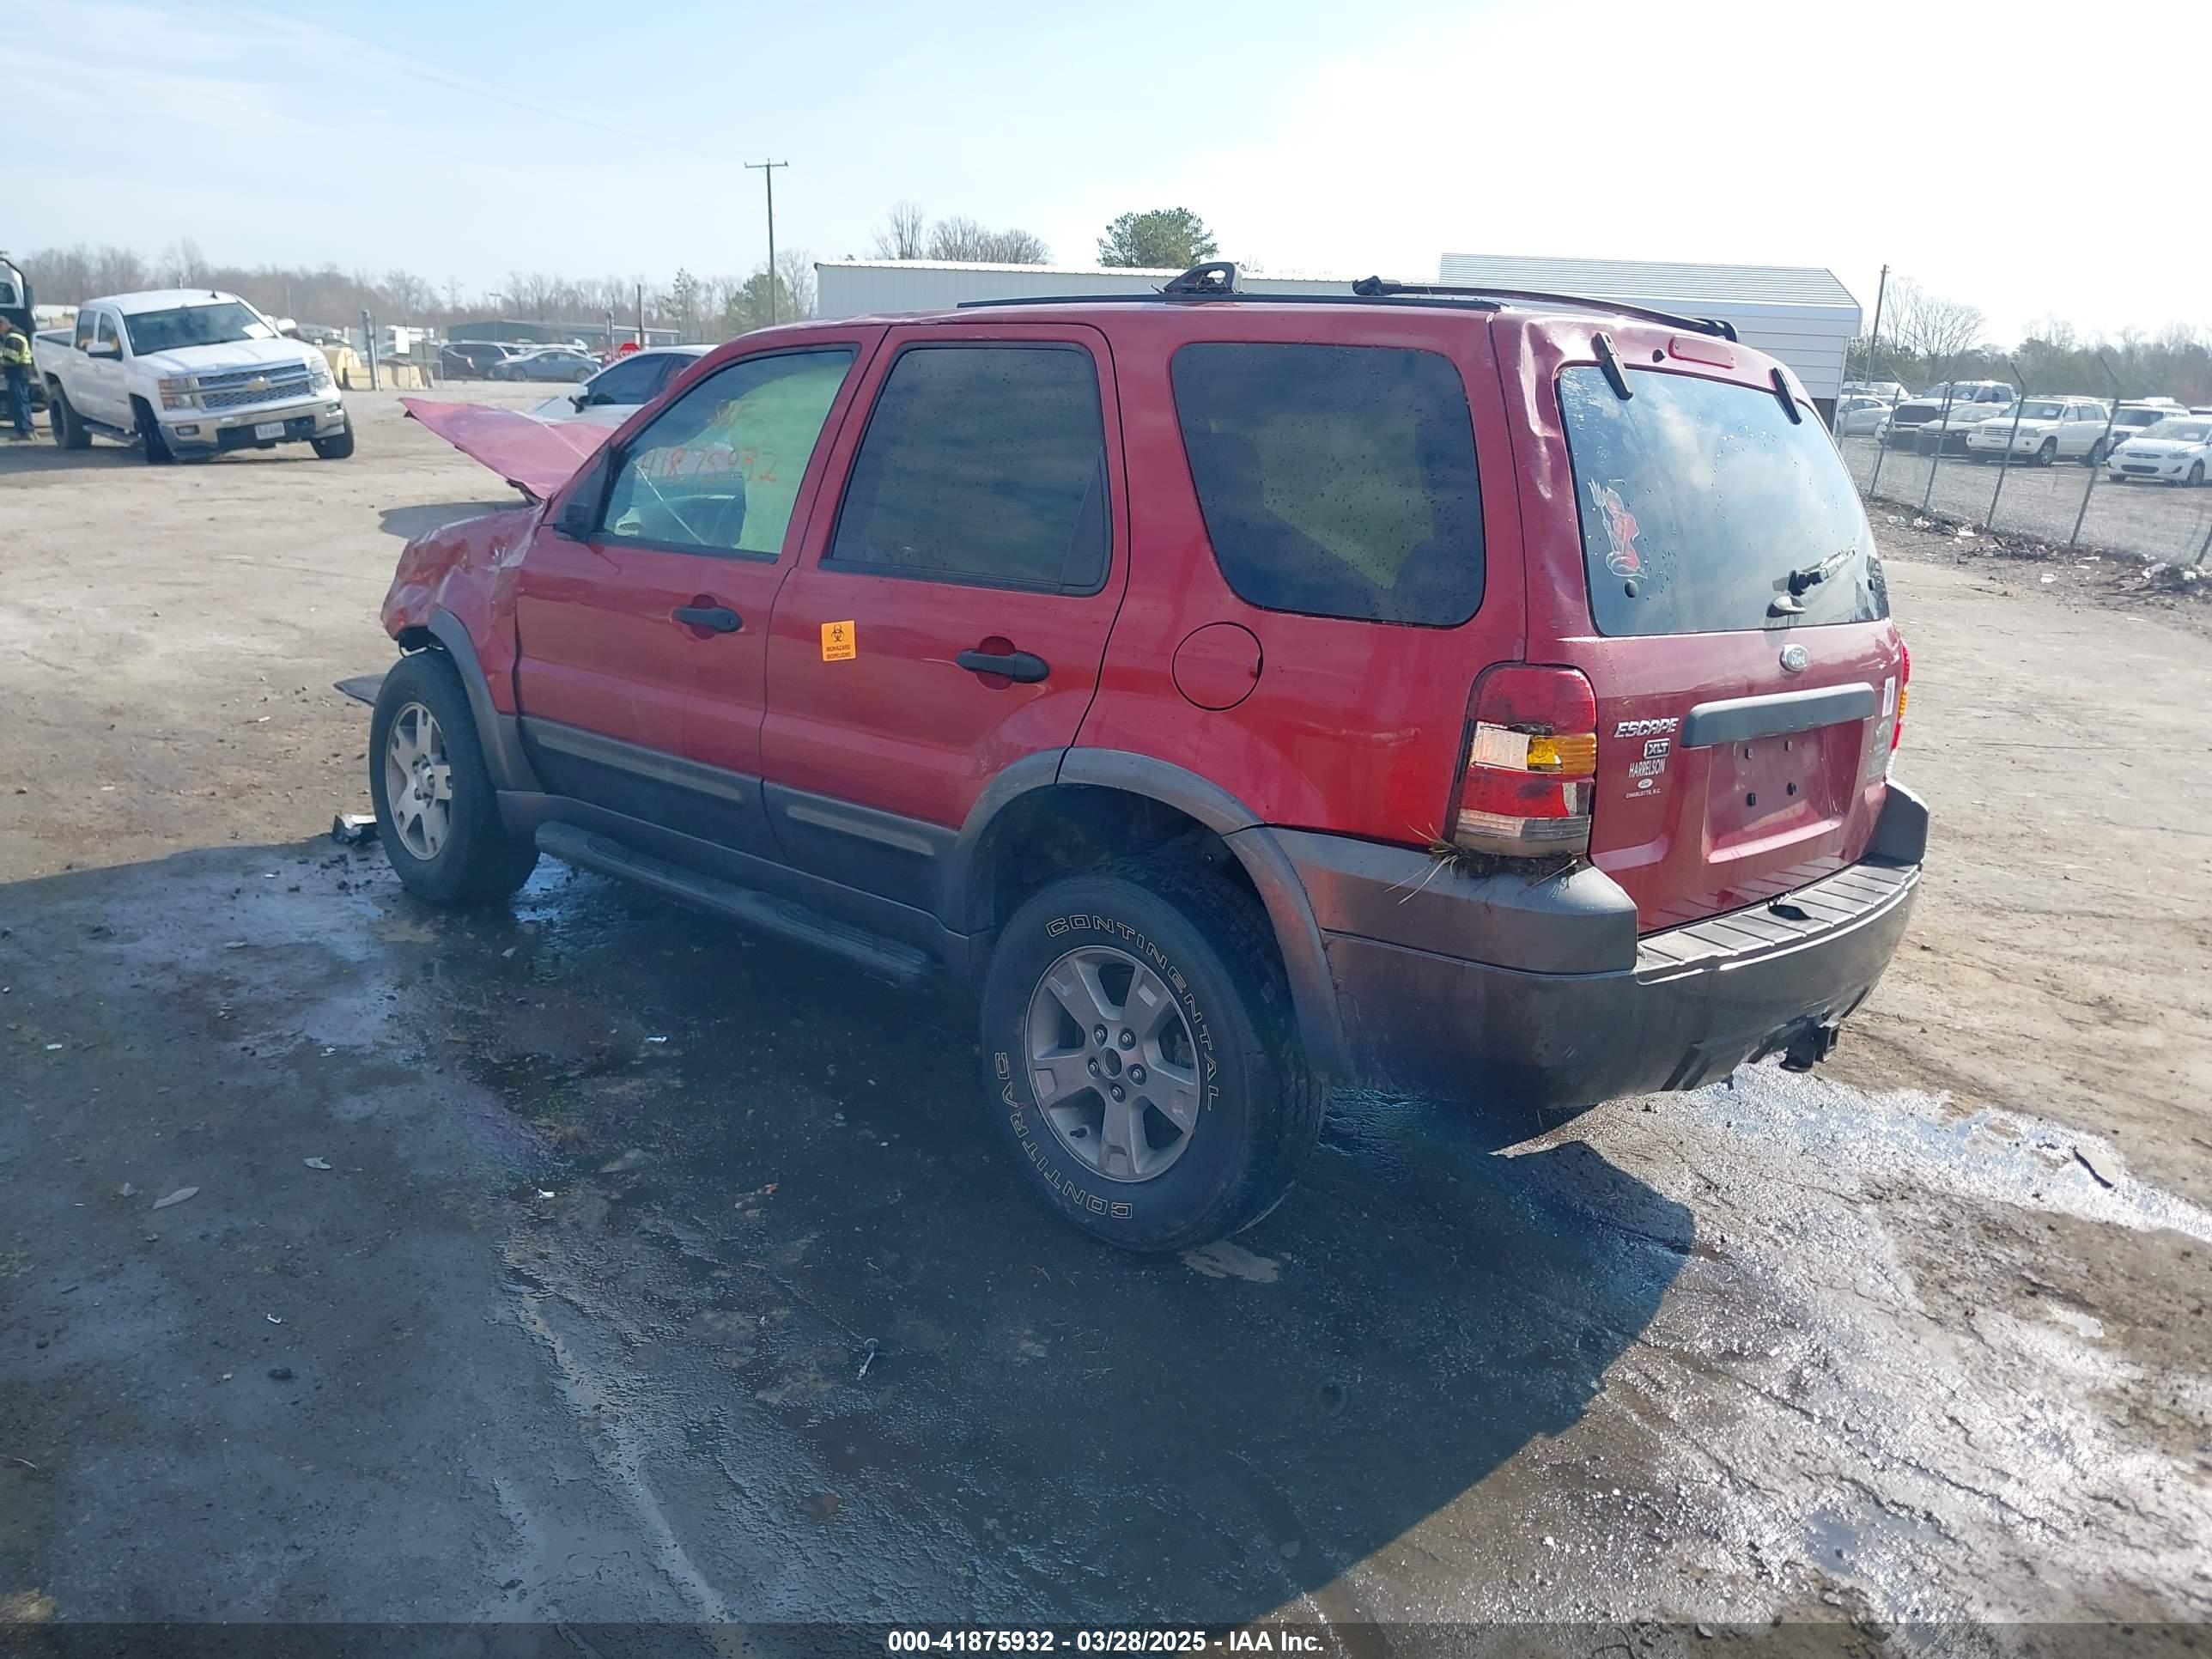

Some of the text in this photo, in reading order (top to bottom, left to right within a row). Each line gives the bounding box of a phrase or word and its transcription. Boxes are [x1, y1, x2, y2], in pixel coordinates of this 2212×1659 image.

[1613, 717, 1680, 738] ESCAPE
[1648, 742, 1668, 755] XLT
[1628, 758, 1666, 779] HARRELSON
[1046, 915, 1218, 1111] CONTINENTAL
[994, 1052, 1133, 1219] CONTITRAC
